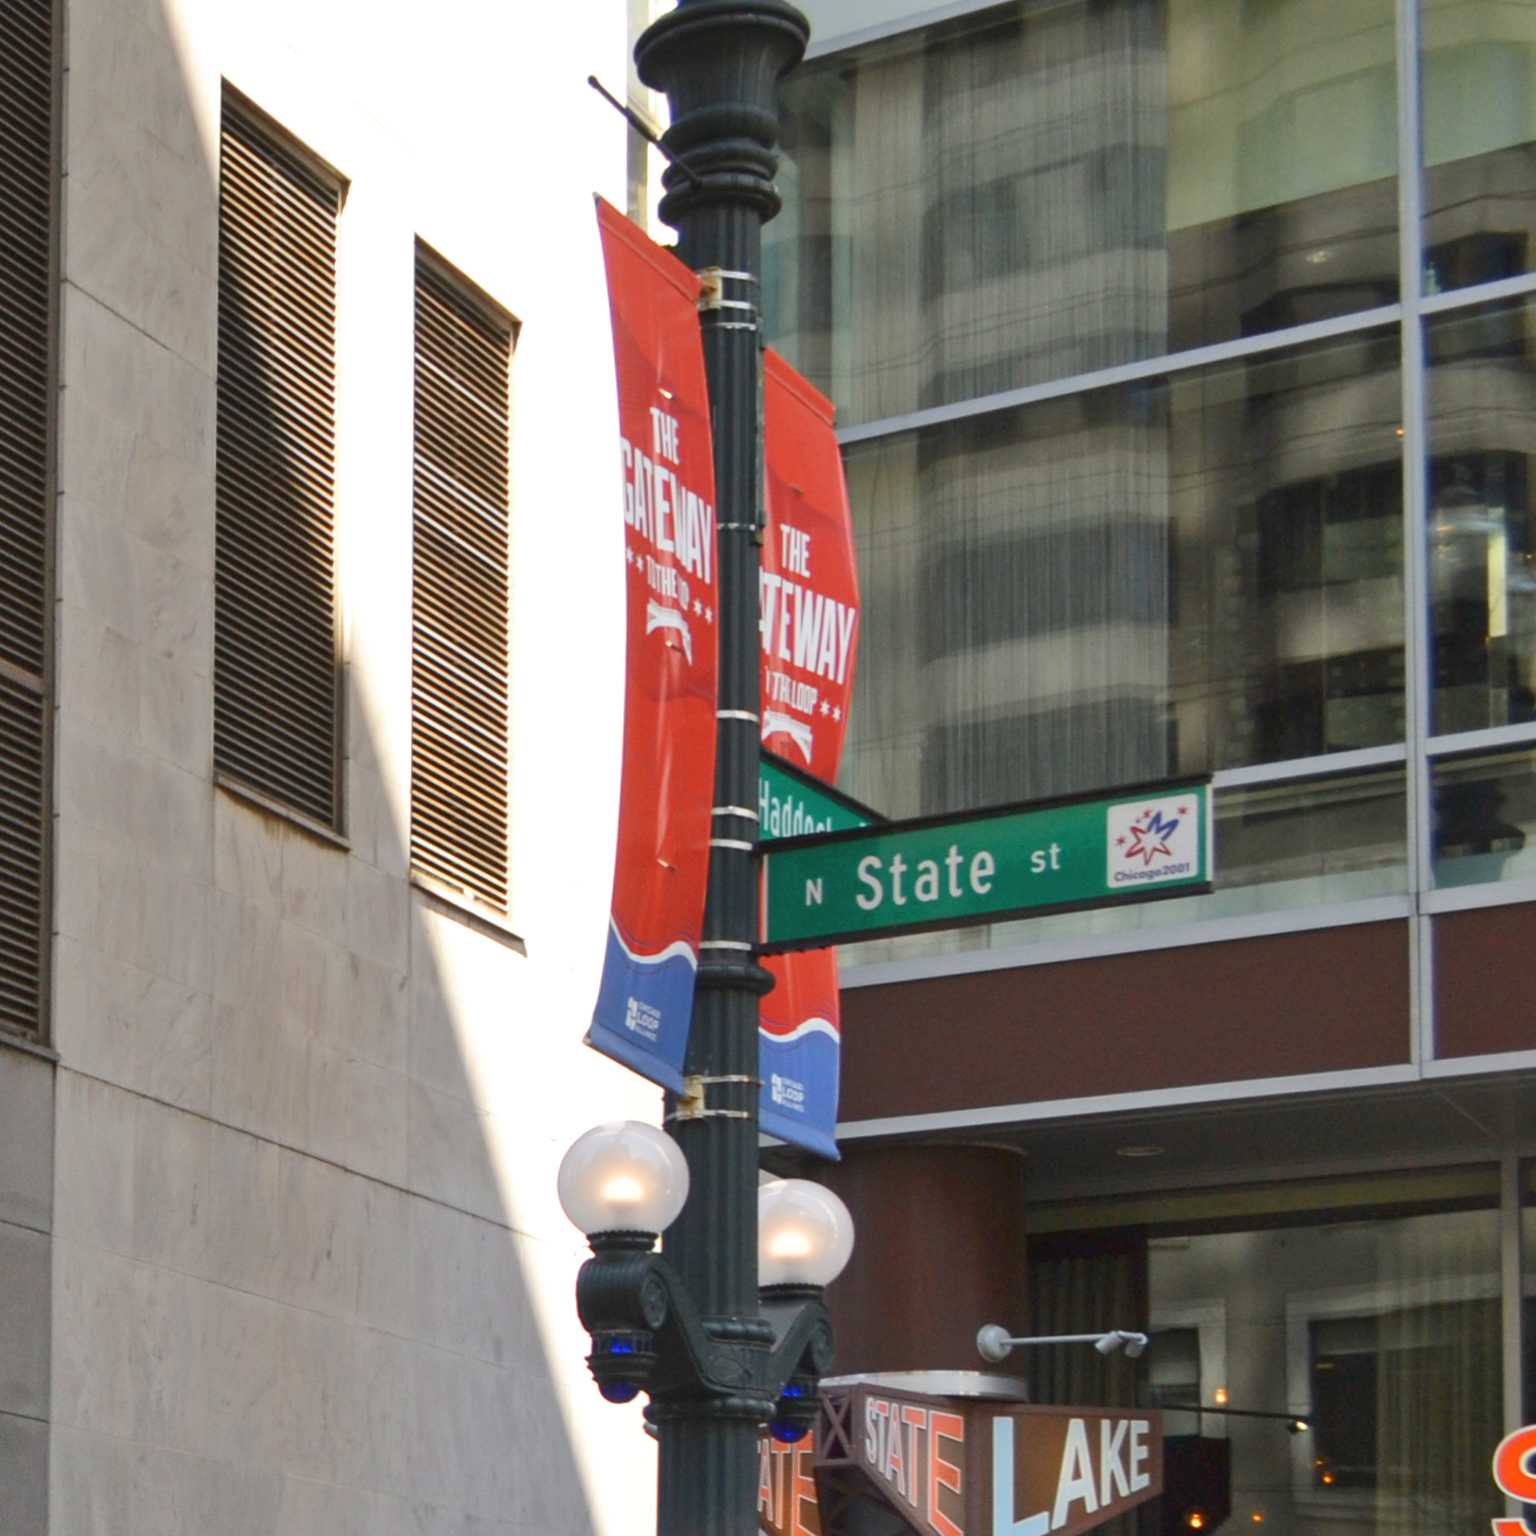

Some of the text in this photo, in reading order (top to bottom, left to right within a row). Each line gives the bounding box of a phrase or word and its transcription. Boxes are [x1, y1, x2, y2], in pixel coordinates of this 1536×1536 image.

[650, 407, 680, 465] THE
[780, 522, 811, 579] THE
[759, 565, 856, 686] TEWAY
[805, 842, 1061, 911] N State st
